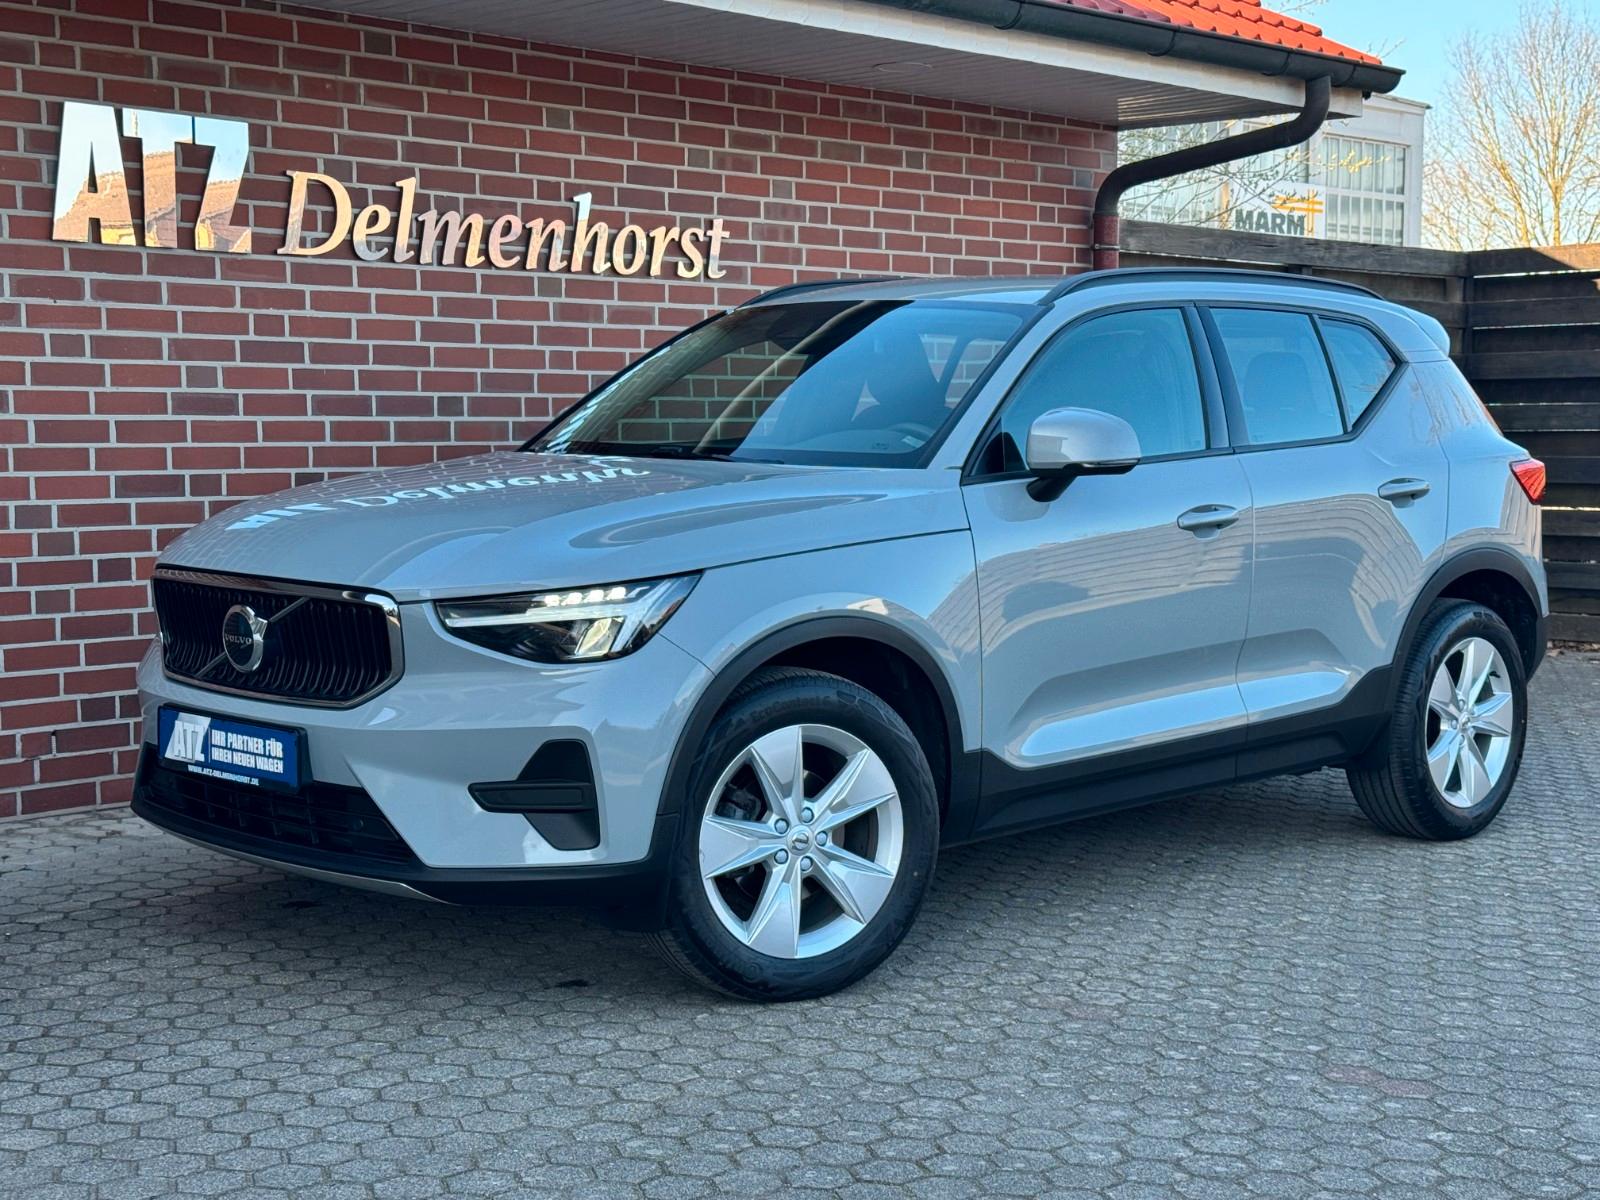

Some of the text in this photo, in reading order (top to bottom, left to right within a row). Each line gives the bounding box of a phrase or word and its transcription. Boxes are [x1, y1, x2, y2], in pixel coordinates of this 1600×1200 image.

[52, 101, 731, 280] ATZ Delmenhorst
[224, 633, 252, 645] VOLVO
[171, 720, 207, 763] ATZ
[211, 729, 284, 758] IHR PARTNER FÜR
[211, 746, 284, 774] IHREN NEUEN WAGEN
